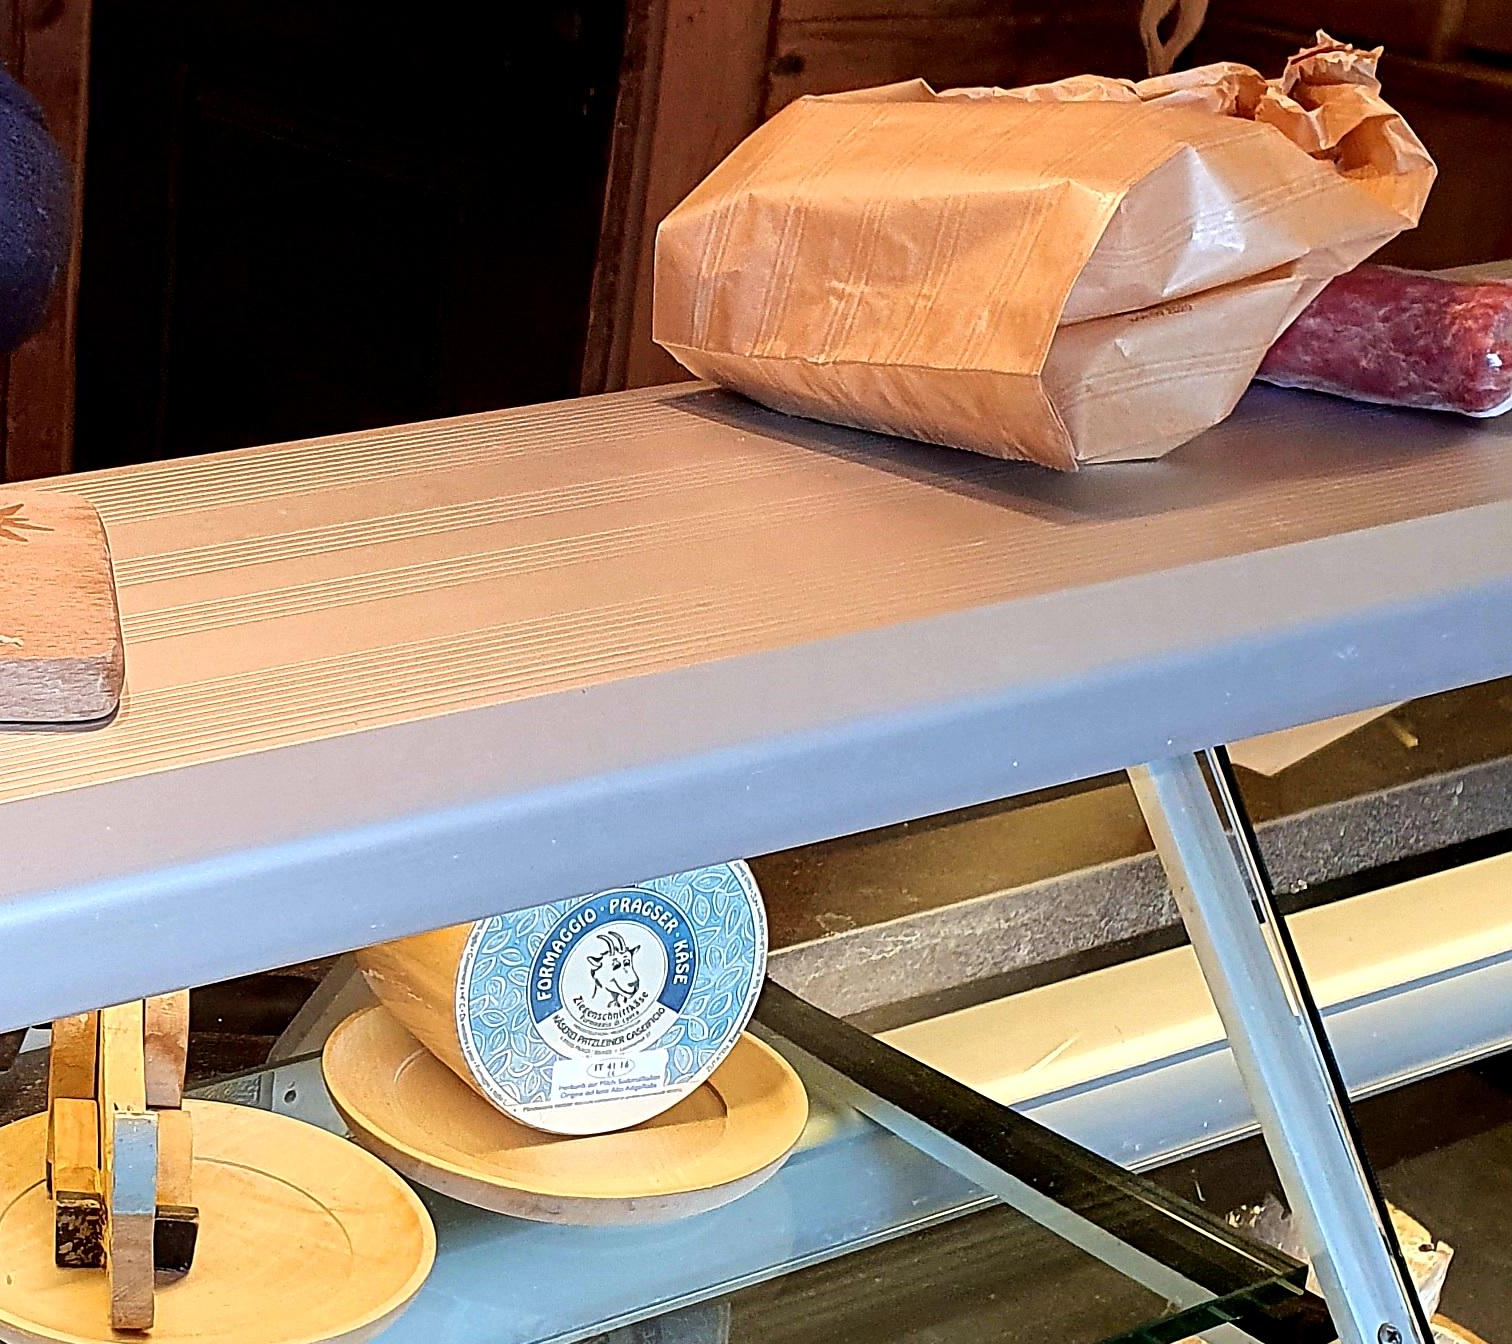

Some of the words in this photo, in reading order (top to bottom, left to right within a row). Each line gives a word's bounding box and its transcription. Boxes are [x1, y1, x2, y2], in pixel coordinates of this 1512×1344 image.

[536, 907, 597, 1002] FORMAGGIO
[609, 897, 679, 933] PRAGSER
[672, 939, 690, 986] KÄSE
